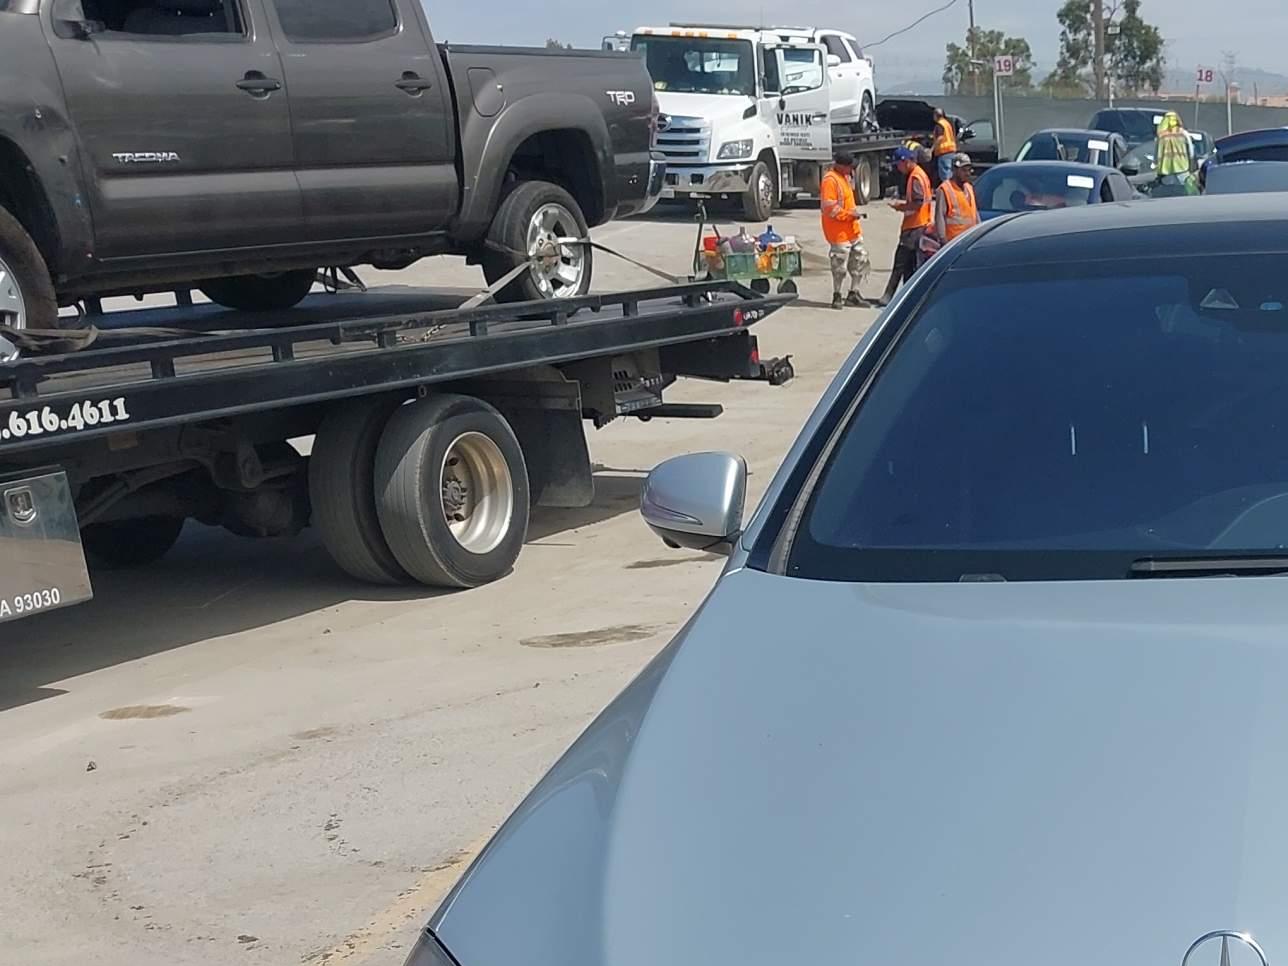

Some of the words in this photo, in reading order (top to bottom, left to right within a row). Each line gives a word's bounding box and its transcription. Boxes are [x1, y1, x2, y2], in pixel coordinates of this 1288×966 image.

[996, 59, 1012, 73] 19
[1196, 69, 1213, 82] 18
[606, 90, 635, 106] TRD
[776, 112, 813, 126] VANIK
[112, 151, 181, 163] TACOMA
[0, 397, 130, 440] .616.4611
[14, 587, 61, 613] 93030
